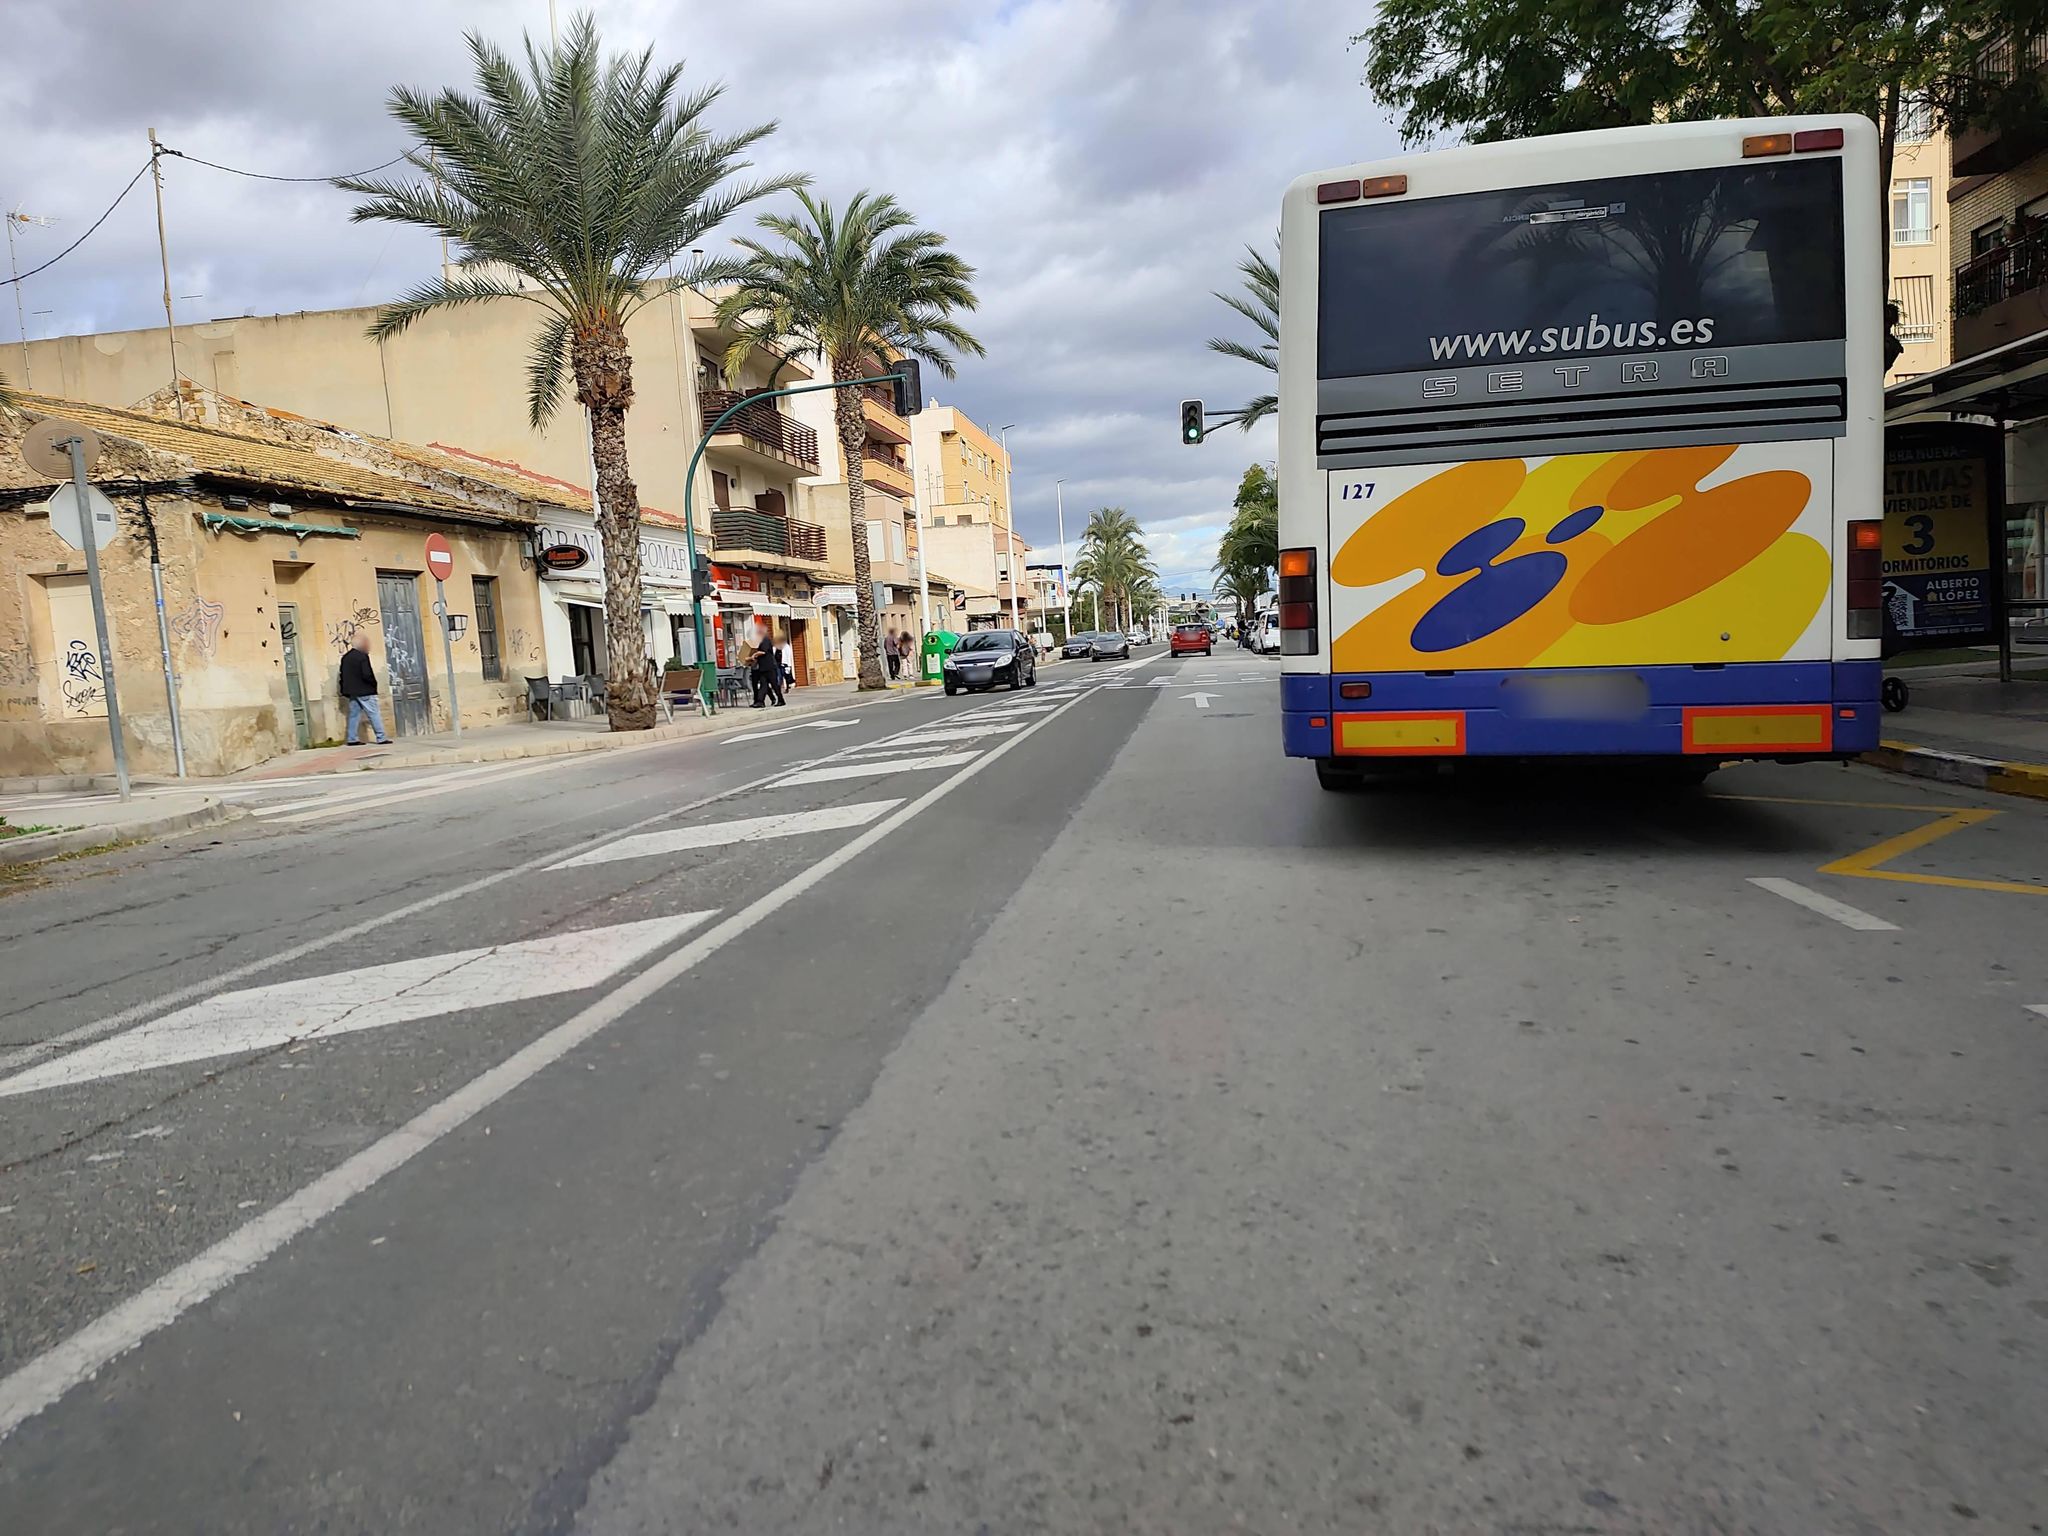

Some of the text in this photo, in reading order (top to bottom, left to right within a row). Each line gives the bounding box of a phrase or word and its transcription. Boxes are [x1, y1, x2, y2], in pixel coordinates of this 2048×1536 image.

[1430, 314, 1714, 360] www.subus.es
[1423, 355, 1728, 398] SETRA
[1884, 465, 1973, 495] LTIMAS
[1343, 483, 1376, 500] 127
[1952, 494, 1972, 508] DE
[1902, 514, 1935, 555] 3
[1882, 555, 1969, 573] ORMITORIOS
[1926, 577, 1980, 590] ALBERTO
[1939, 588, 1980, 601] LÓPEZ
